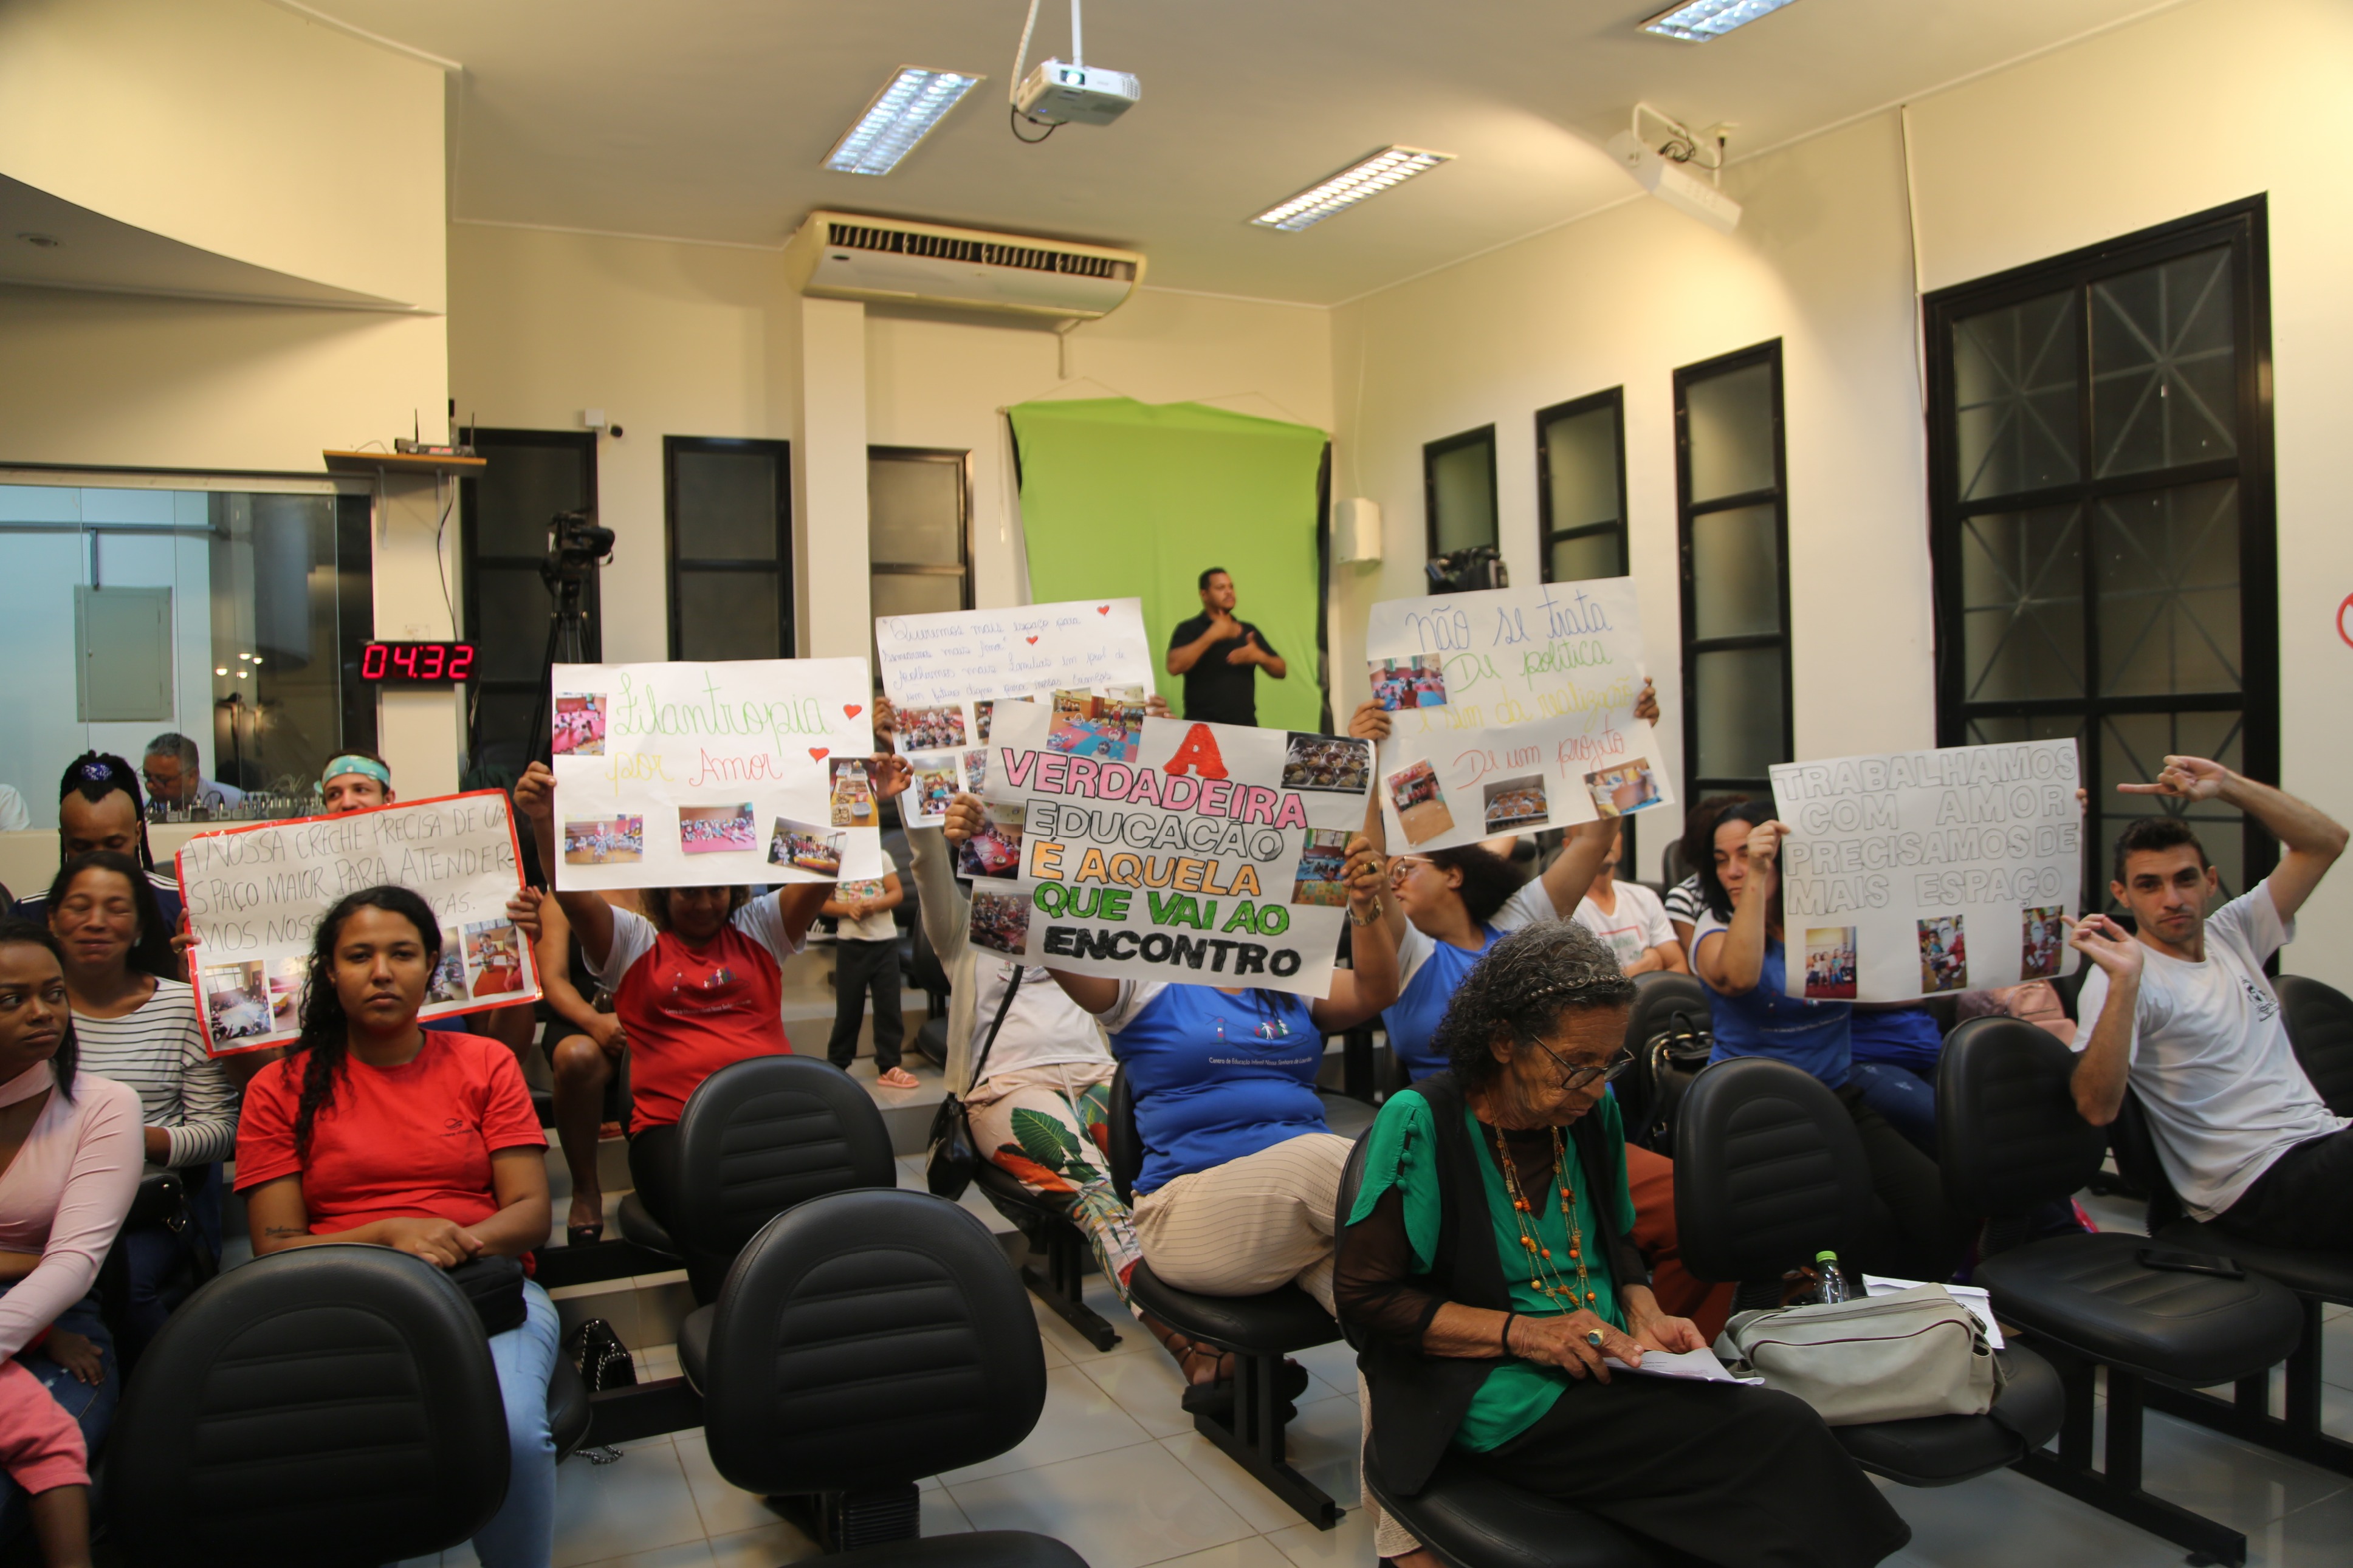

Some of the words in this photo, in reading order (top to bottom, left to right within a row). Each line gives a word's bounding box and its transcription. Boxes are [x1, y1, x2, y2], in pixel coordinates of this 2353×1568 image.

[1056, 617, 1082, 631] para
[605, 750, 675, 796] por
[688, 747, 784, 787] Amor
[1162, 722, 1229, 780] A
[1507, 745, 1541, 770] um
[1556, 713, 1625, 779] projeto
[1771, 745, 2077, 801] TRABALHAMOS
[1000, 747, 1308, 830] VERDADEIRA
[1799, 793, 1899, 835] COM
[1936, 784, 2066, 826] AMOR
[180, 839, 200, 874] A
[206, 830, 286, 871] NOSSA
[296, 821, 363, 859] CRECHE
[372, 812, 442, 846] PRECISA
[453, 807, 476, 837] DE
[1023, 798, 1284, 862] EDUCAÇÃO
[1783, 824, 2031, 877] PRECISAMOS
[2035, 821, 2079, 858] DE
[267, 866, 330, 904] MAIOR
[335, 857, 390, 895] PARA
[1029, 837, 1065, 881] É
[1074, 848, 1261, 897] AQUELA
[1787, 873, 1889, 916] MAIS
[1914, 866, 2062, 909] ESPAÇO
[1033, 882, 1132, 921] QUE
[1147, 891, 1218, 930] VAI
[1221, 900, 1290, 936] AO
[1043, 925, 1302, 977] ENCONTRO
